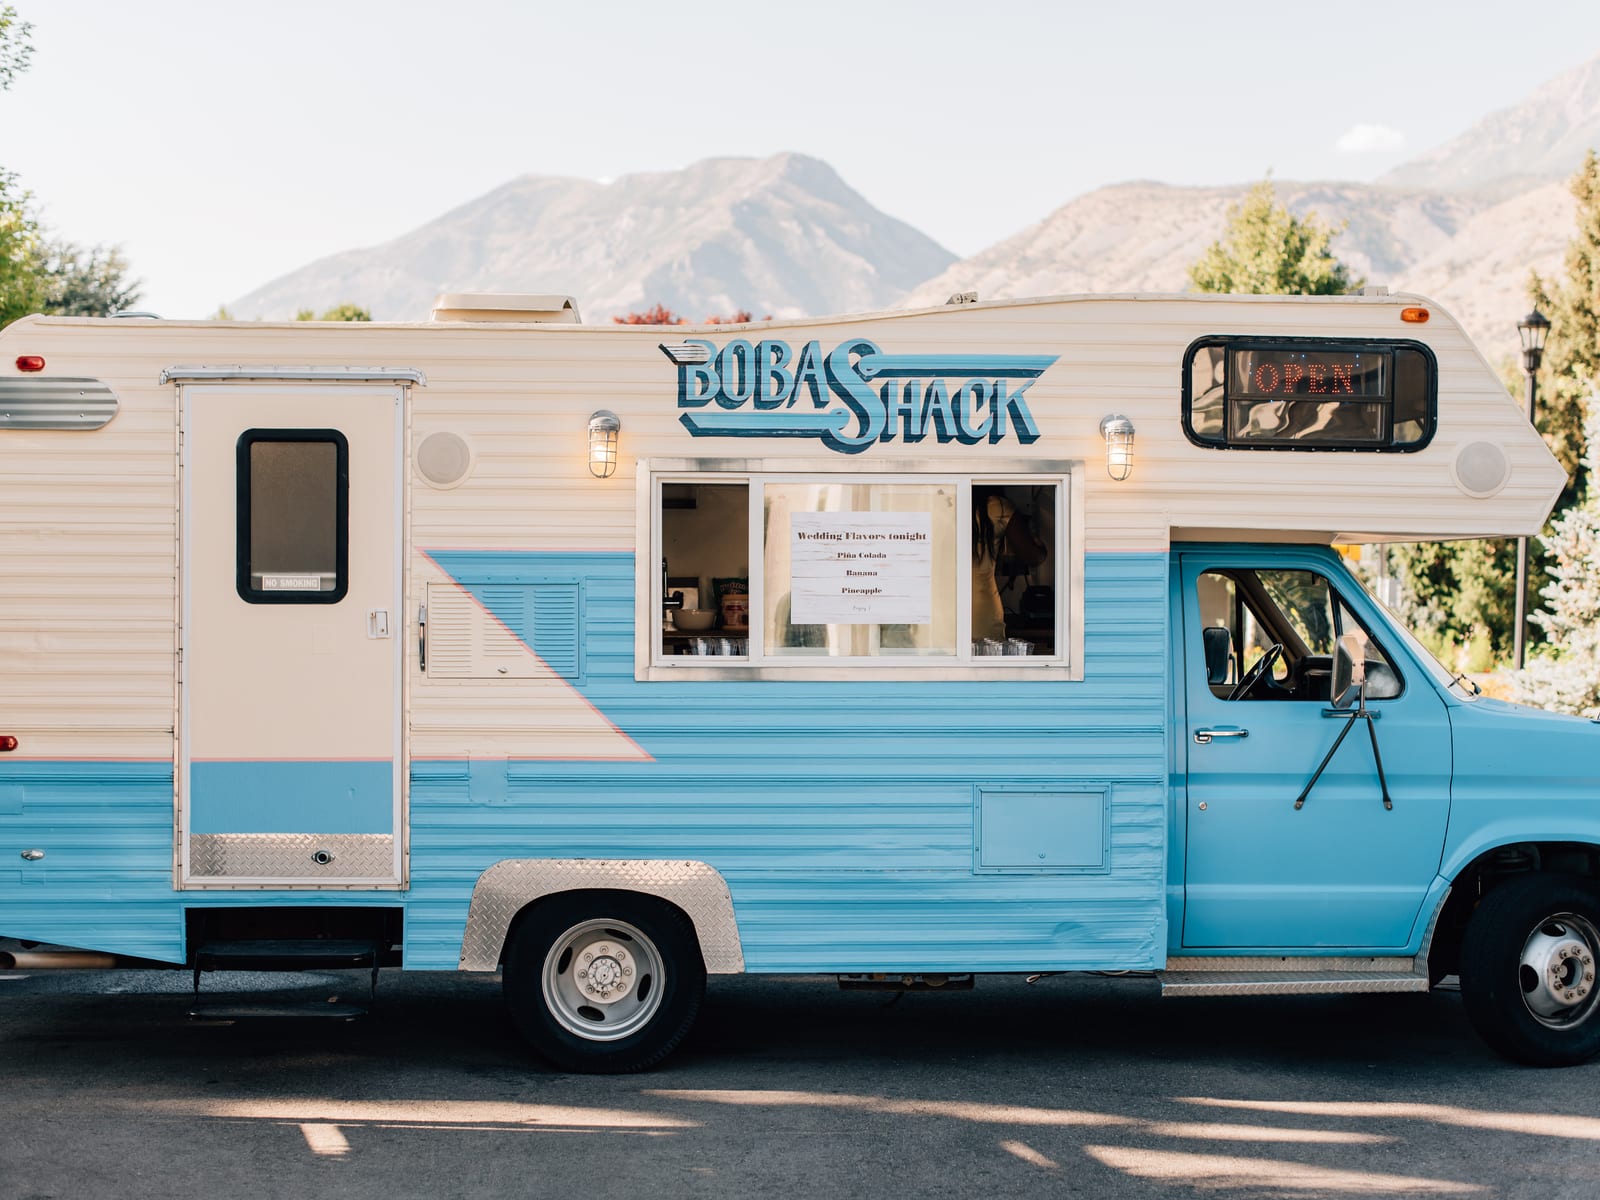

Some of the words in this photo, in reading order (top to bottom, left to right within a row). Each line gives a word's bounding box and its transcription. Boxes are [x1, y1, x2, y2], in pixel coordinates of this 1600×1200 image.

[1255, 363, 1354, 394] OPEN
[677, 339, 829, 410] BOBA
[823, 338, 1050, 454] SHACK
[797, 532, 842, 541] Wedding
[845, 532, 886, 541] Flavors
[888, 532, 927, 541] tonight
[265, 578, 278, 588] NO
[280, 578, 318, 588] SMOKING
[841, 587, 883, 595] Pineapple
